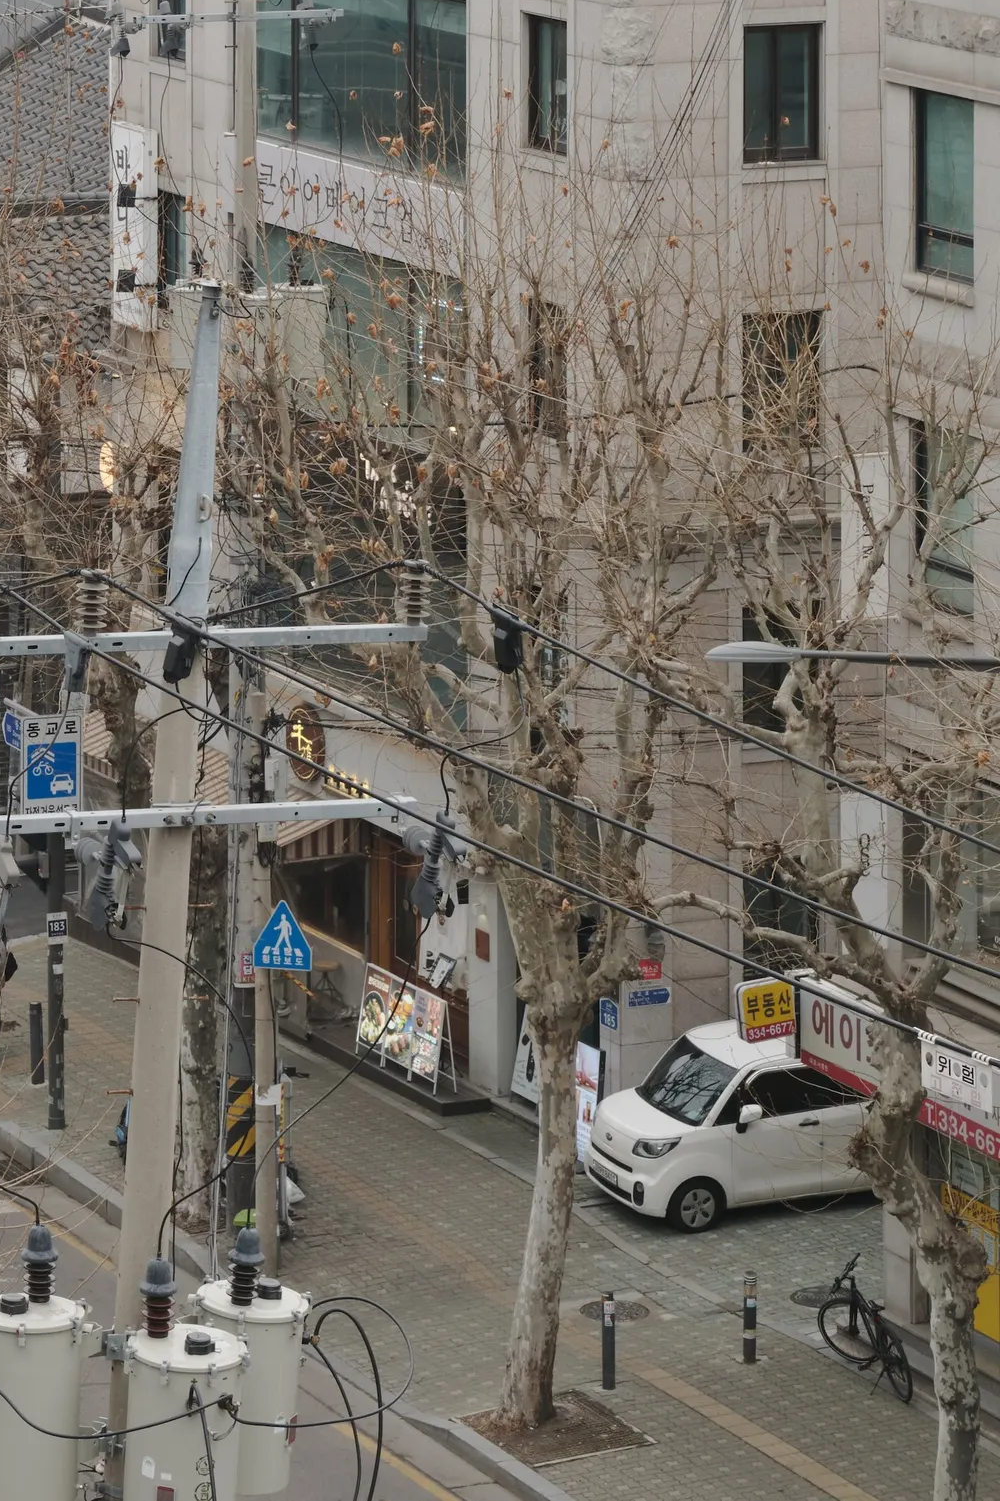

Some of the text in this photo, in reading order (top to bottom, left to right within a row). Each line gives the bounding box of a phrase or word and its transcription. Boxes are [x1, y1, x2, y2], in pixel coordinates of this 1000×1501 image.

[26, 720, 78, 738] 동교로
[49, 920, 65, 932] 183
[262, 954, 304, 966] 횡단보도
[747, 989, 791, 1021] 부동산
[603, 1012, 616, 1028] 185
[748, 1020, 793, 1040] 334-6677
[811, 999, 872, 1064] 에이
[938, 1055, 975, 1086] 위험
